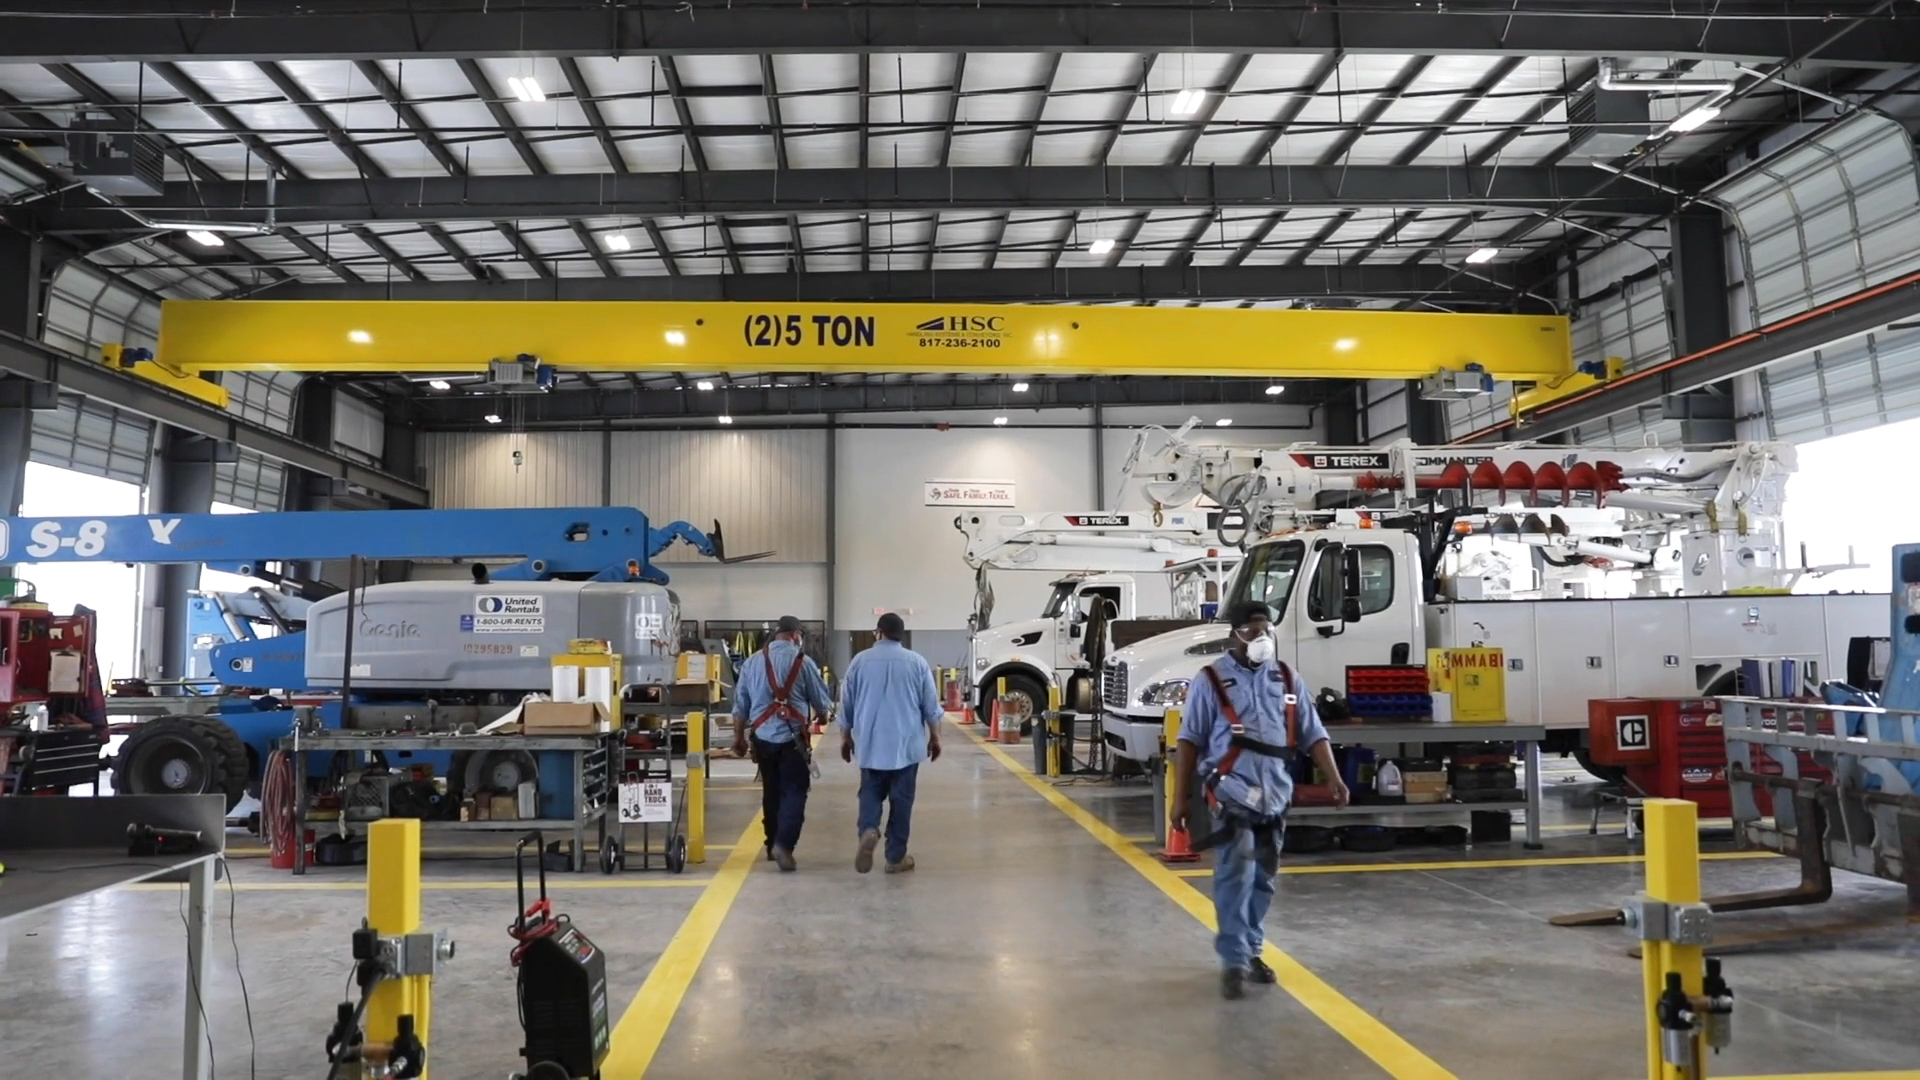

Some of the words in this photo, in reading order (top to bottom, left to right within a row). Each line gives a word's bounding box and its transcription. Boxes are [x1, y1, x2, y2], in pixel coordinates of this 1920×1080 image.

[949, 315, 1006, 332] HSC
[744, 314, 803, 347] (2)5
[811, 315, 876, 347] TON
[919, 338, 1001, 348] 817-236-2100
[1331, 456, 1379, 467] TEREX
[1414, 456, 1494, 467] OMMANDER
[505, 597, 538, 605] United
[504, 606, 541, 614] Rentals
